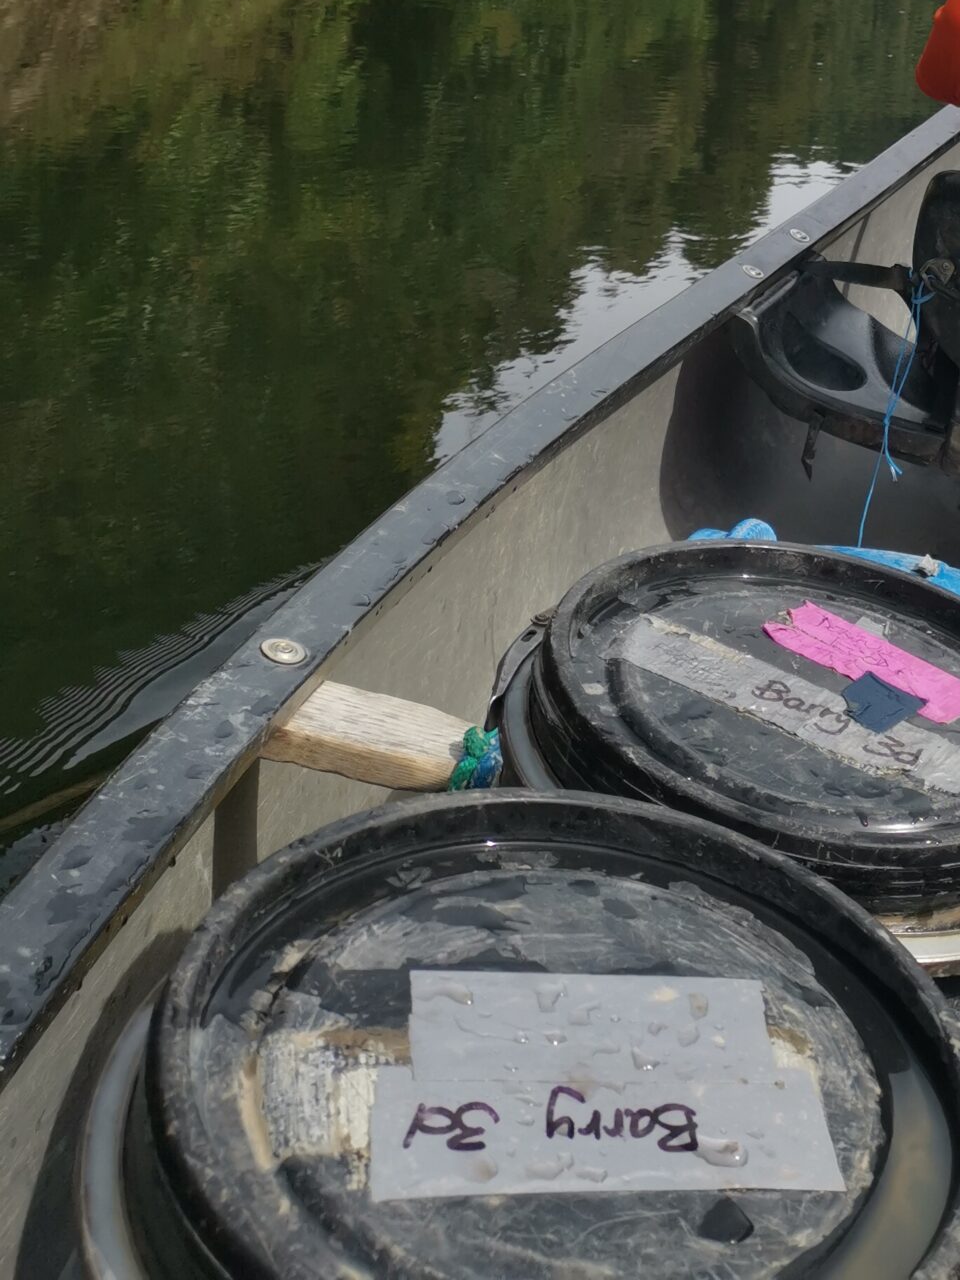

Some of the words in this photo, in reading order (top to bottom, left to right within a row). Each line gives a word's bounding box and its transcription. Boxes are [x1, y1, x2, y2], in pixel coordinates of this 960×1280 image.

[752, 680, 850, 735] Barry
[863, 736, 923, 766] 3d
[403, 1101, 500, 1151] 3d
[546, 1086, 698, 1152] Barry
